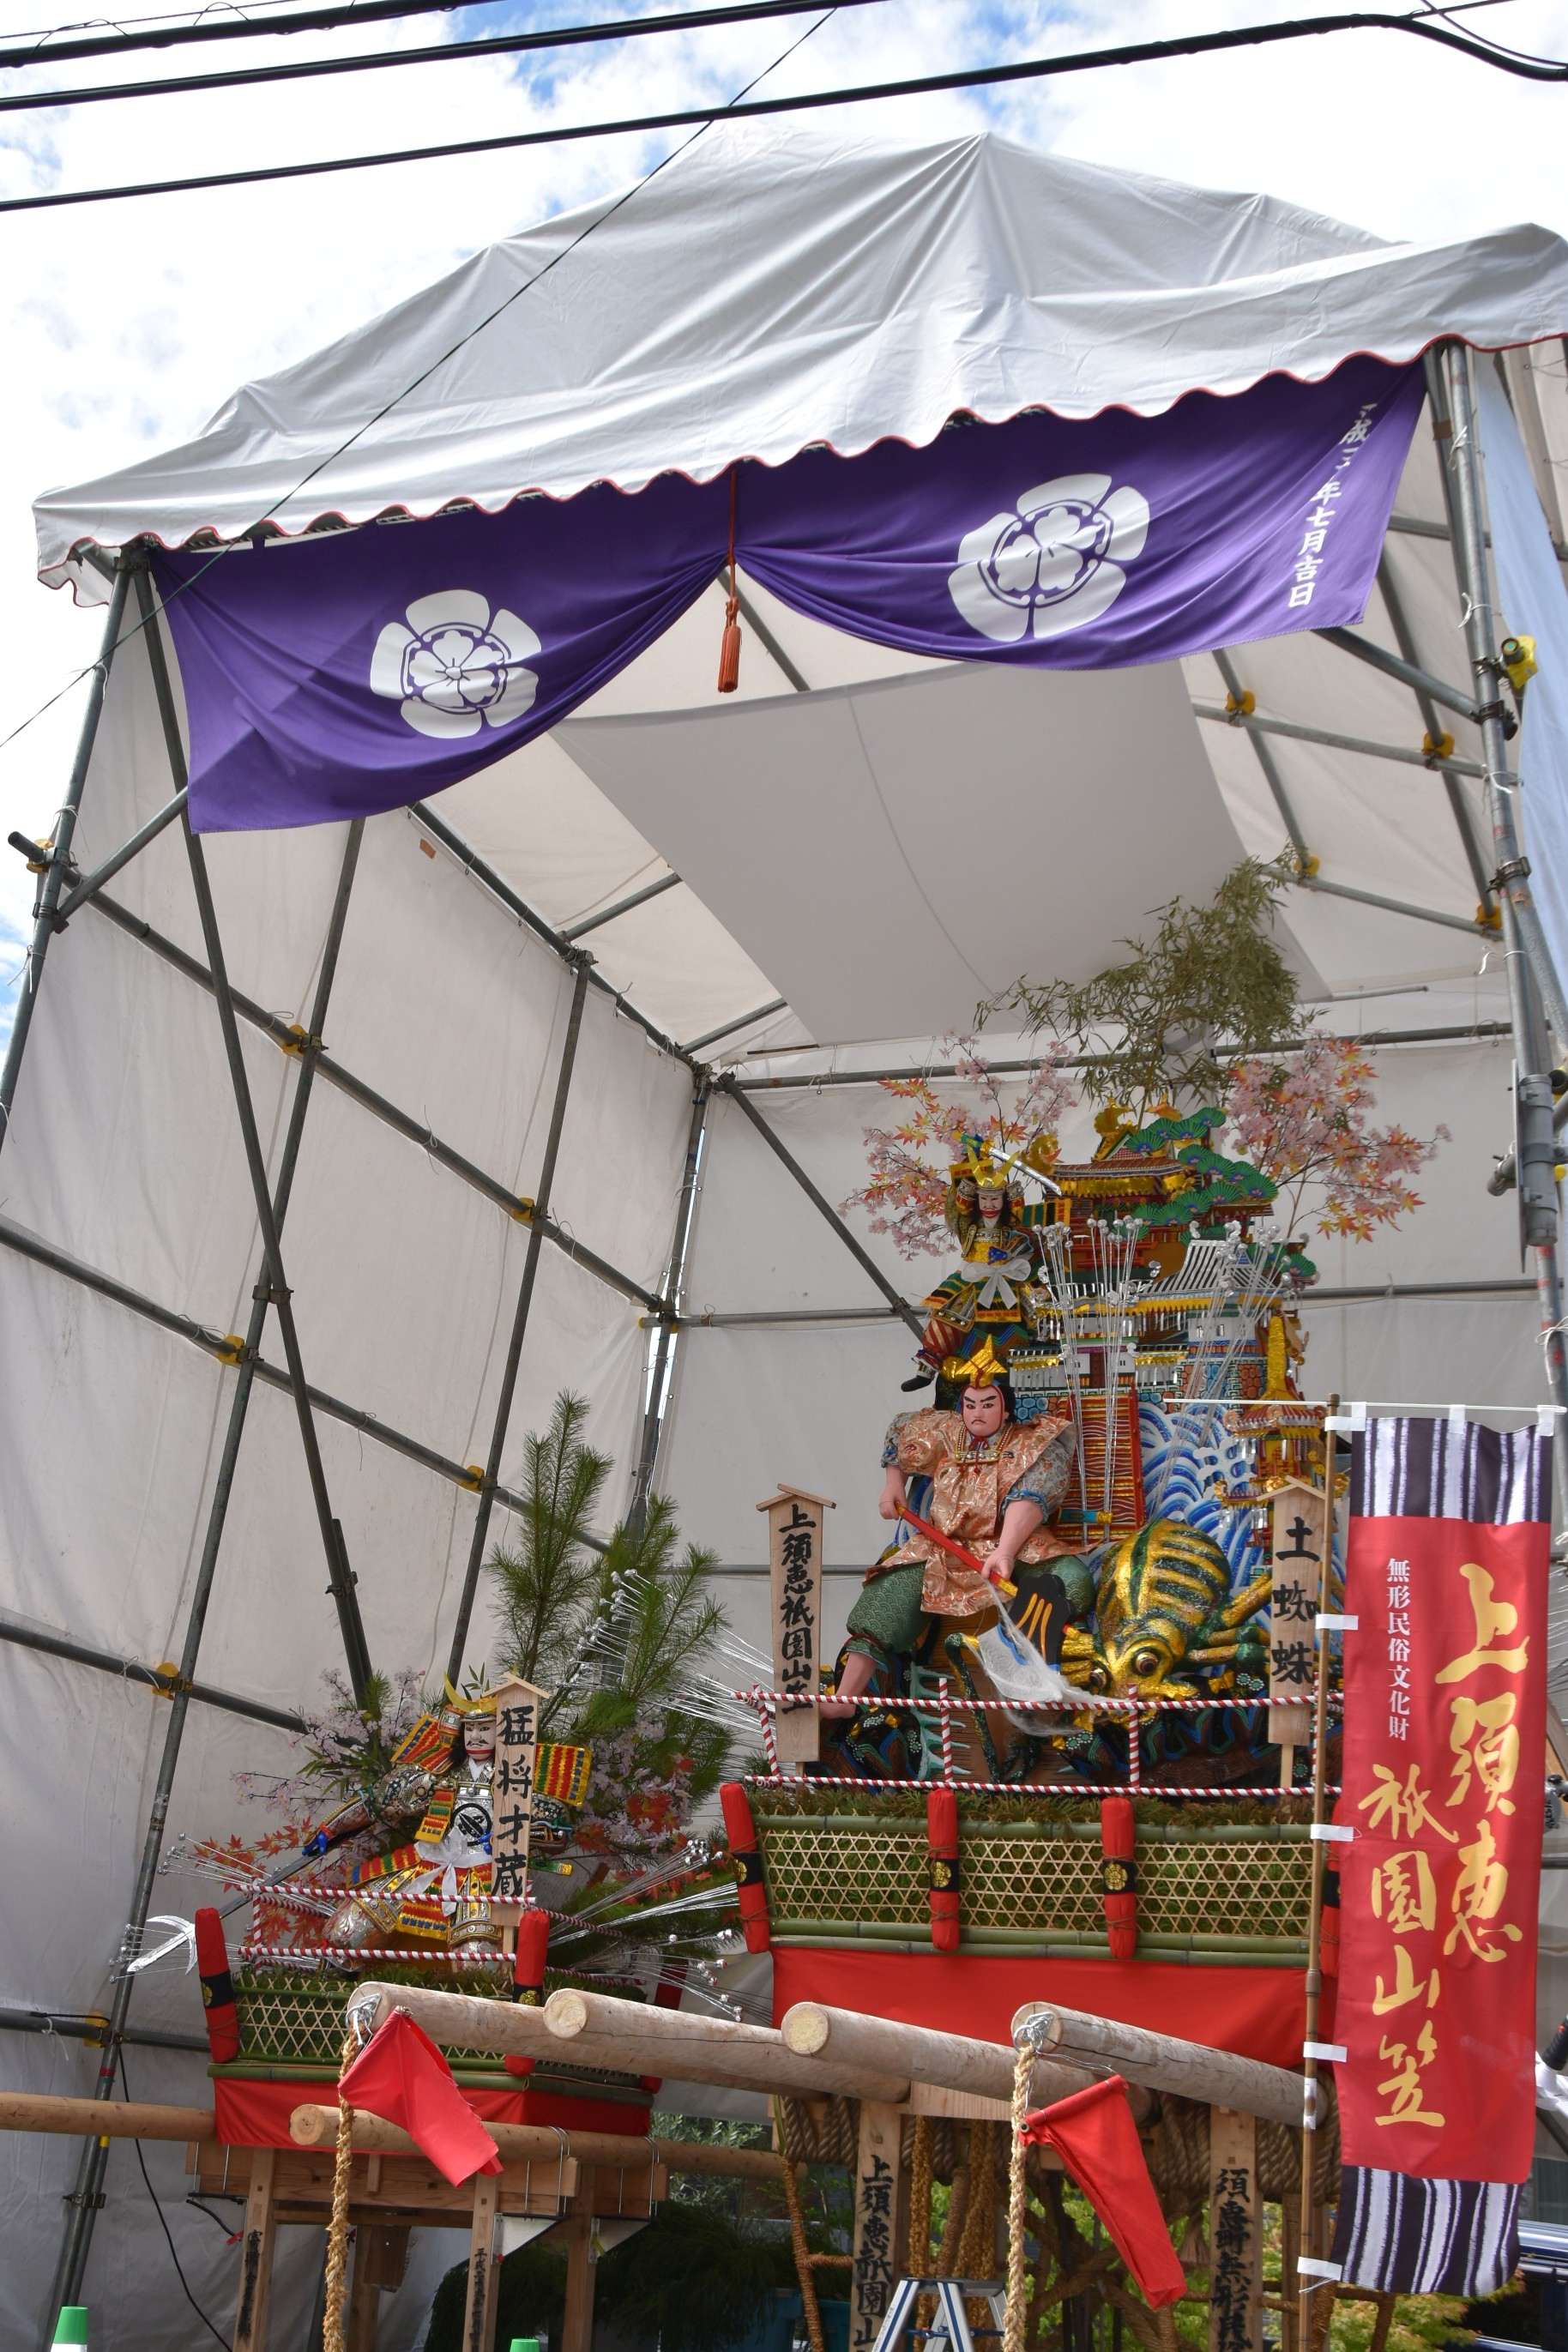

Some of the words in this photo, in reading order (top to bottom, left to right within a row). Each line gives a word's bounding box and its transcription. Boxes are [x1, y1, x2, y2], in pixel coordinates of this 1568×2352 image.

[1272, 1517, 1320, 1685] 土蜘蛛
[1386, 1558, 1411, 1741] 無形民俗文化財
[491, 1704, 534, 1897] 猛将才蔵
